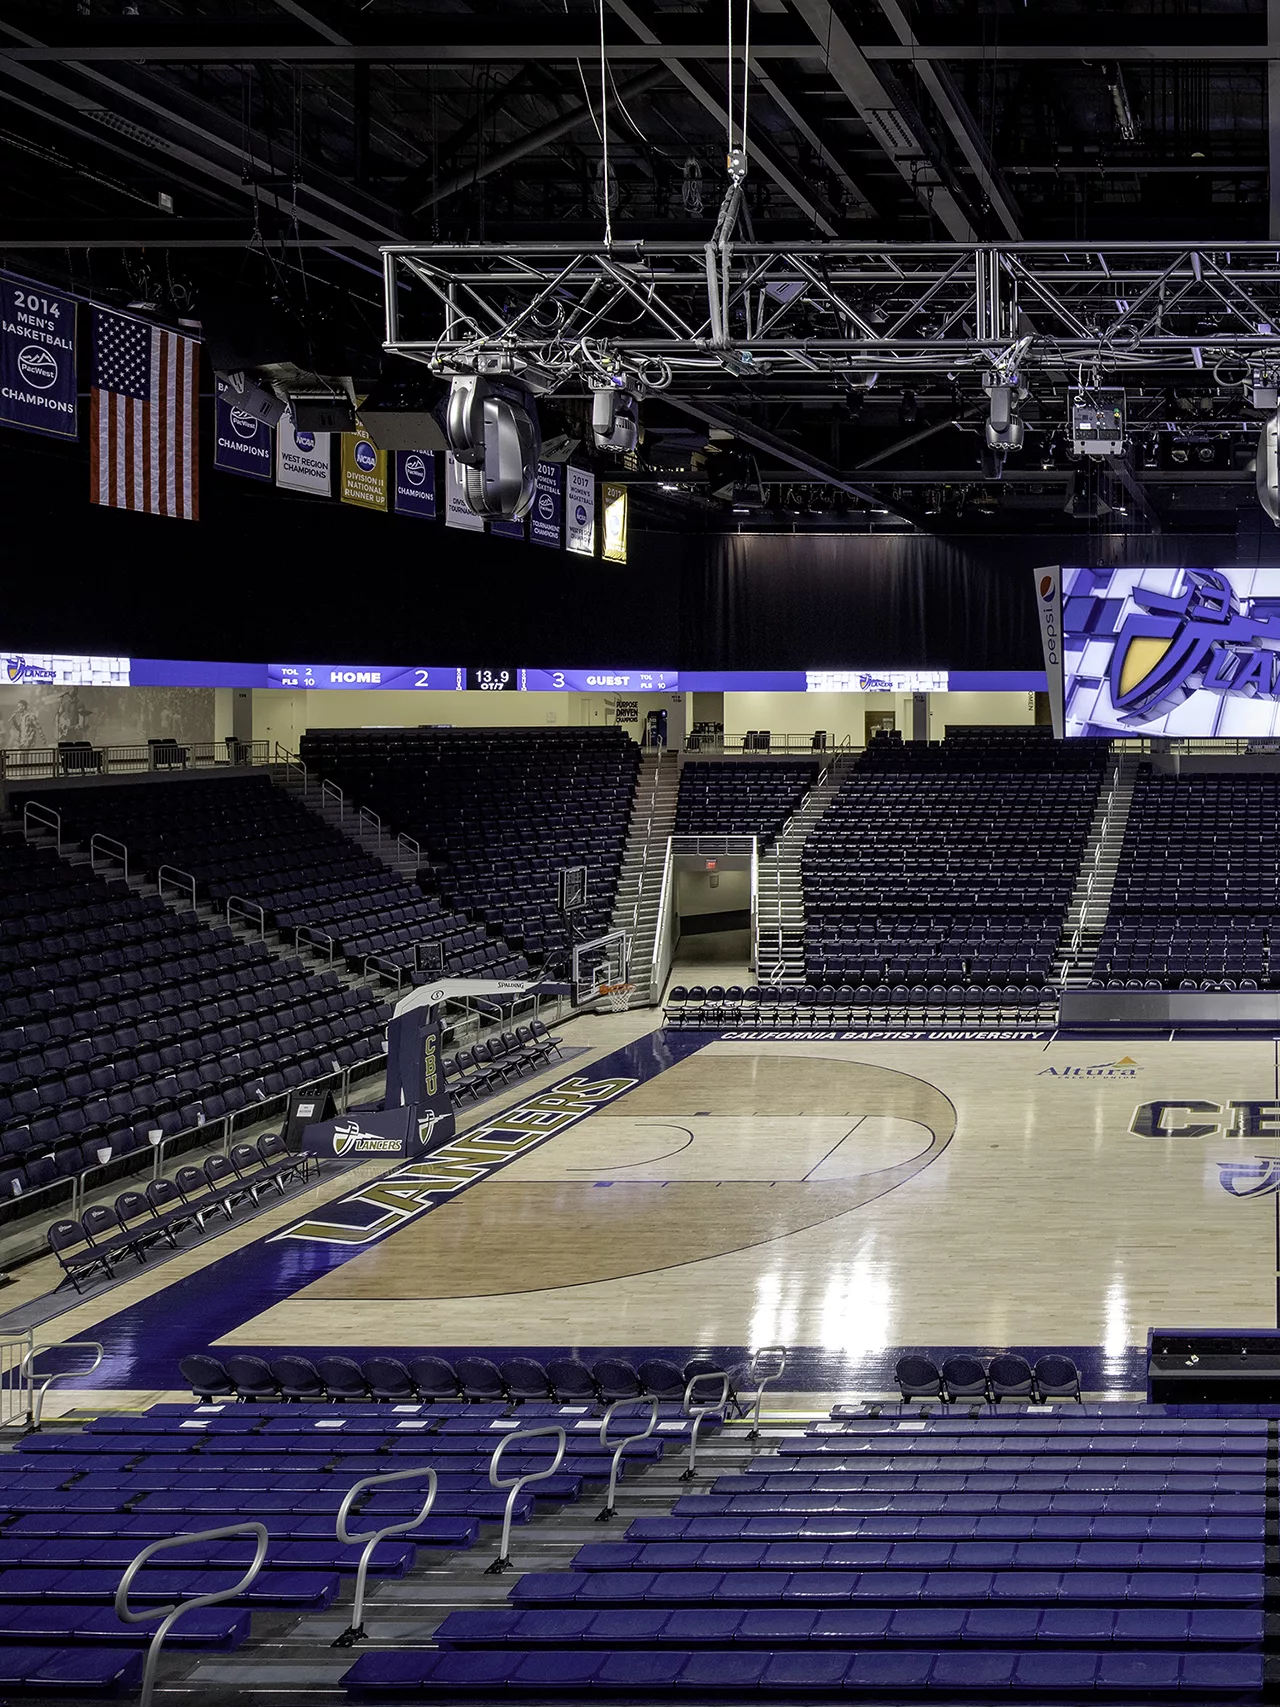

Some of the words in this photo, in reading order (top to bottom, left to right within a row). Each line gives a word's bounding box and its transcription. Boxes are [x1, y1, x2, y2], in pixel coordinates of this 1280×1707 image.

[14, 290, 60, 318] 2014
[17, 311, 55, 331] MEN'S
[21, 363, 55, 379] PacWest
[1, 387, 74, 413] CHAMPIONS
[218, 438, 269, 458] CHAMPIONS
[281, 452, 300, 463] WEST
[301, 457, 328, 470] REGION
[283, 463, 326, 479] CHAMPIONS
[537, 463, 555, 476] 2017
[346, 471, 377, 486] DIVISION
[573, 475, 589, 487] 2017
[347, 480, 383, 495] NATIONAL
[397, 487, 434, 501] CHAMPIONS
[344, 489, 374, 502] RUNNER
[375, 496, 385, 504] UP
[1043, 608, 1059, 665] pepsi
[24, 669, 57, 678] LANCERS
[330, 672, 381, 683] HOME
[414, 670, 428, 687] 2
[476, 670, 509, 683] 13.9
[552, 672, 565, 687] 3
[586, 676, 630, 686] GUEST
[720, 1032, 835, 1040] CALIFORNIA
[841, 1032, 926, 1040] BAPTIST
[929, 1032, 1045, 1040] UNIVERSITY
[425, 1034, 437, 1096] CBU
[1036, 1066, 1138, 1076] Altura
[355, 1139, 402, 1151] LANCERS
[265, 1077, 639, 1246] LANCERS
